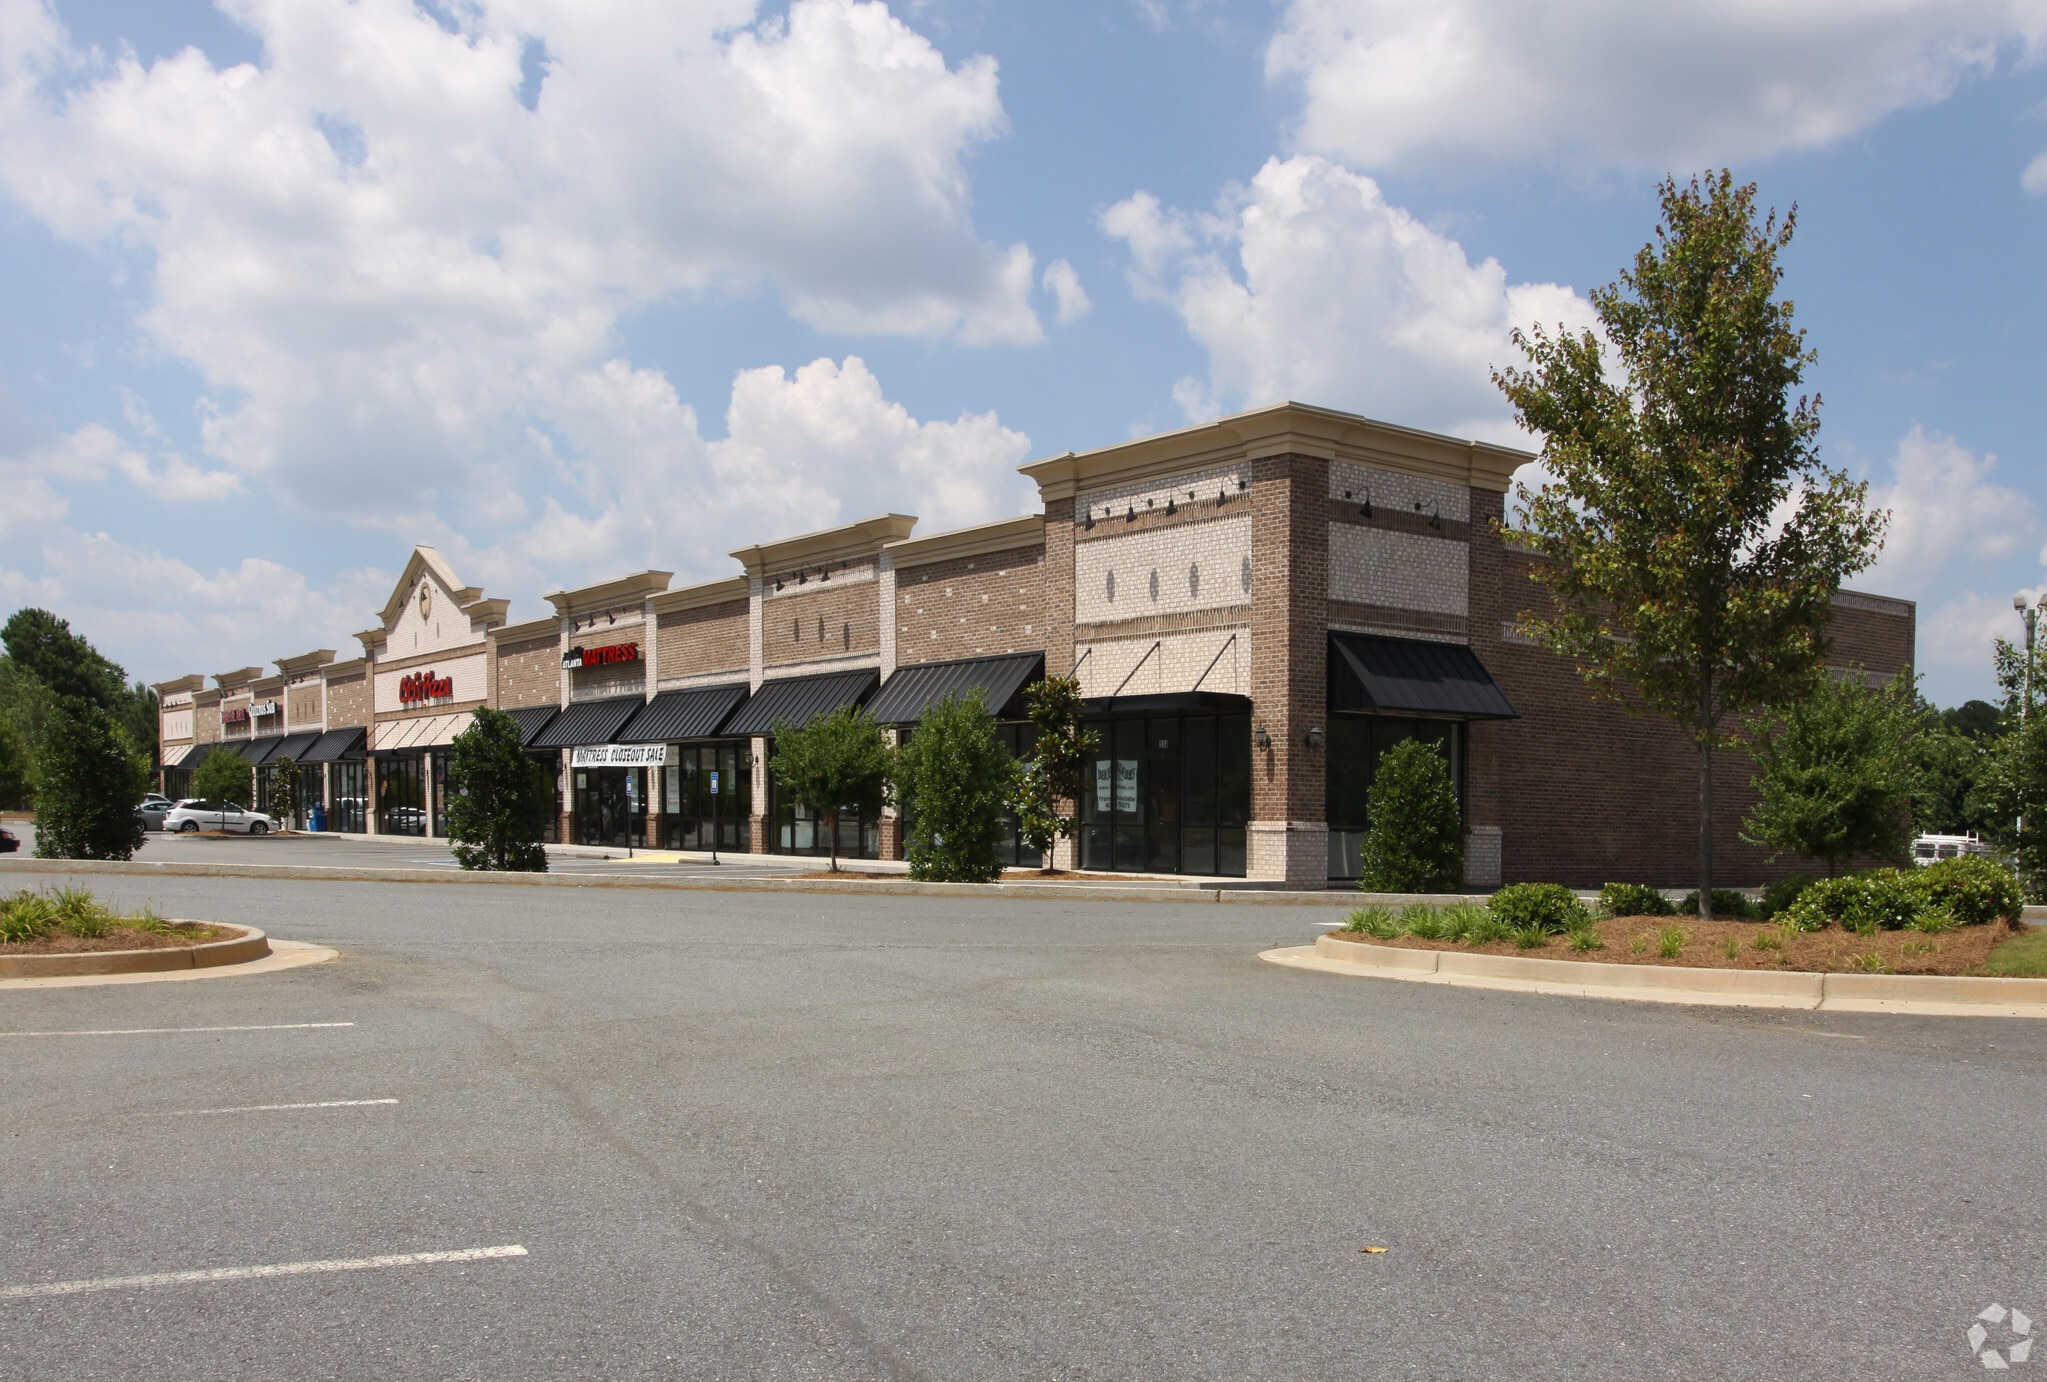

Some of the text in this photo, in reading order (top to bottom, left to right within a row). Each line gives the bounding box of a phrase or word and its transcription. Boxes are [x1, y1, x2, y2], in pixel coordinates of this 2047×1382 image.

[583, 642, 636, 667] MATTRESS
[562, 658, 582, 668] ATLANTA
[576, 748, 608, 763] MATTRESS
[611, 748, 645, 762] CLOSEOUT
[646, 747, 664, 762] SALE
